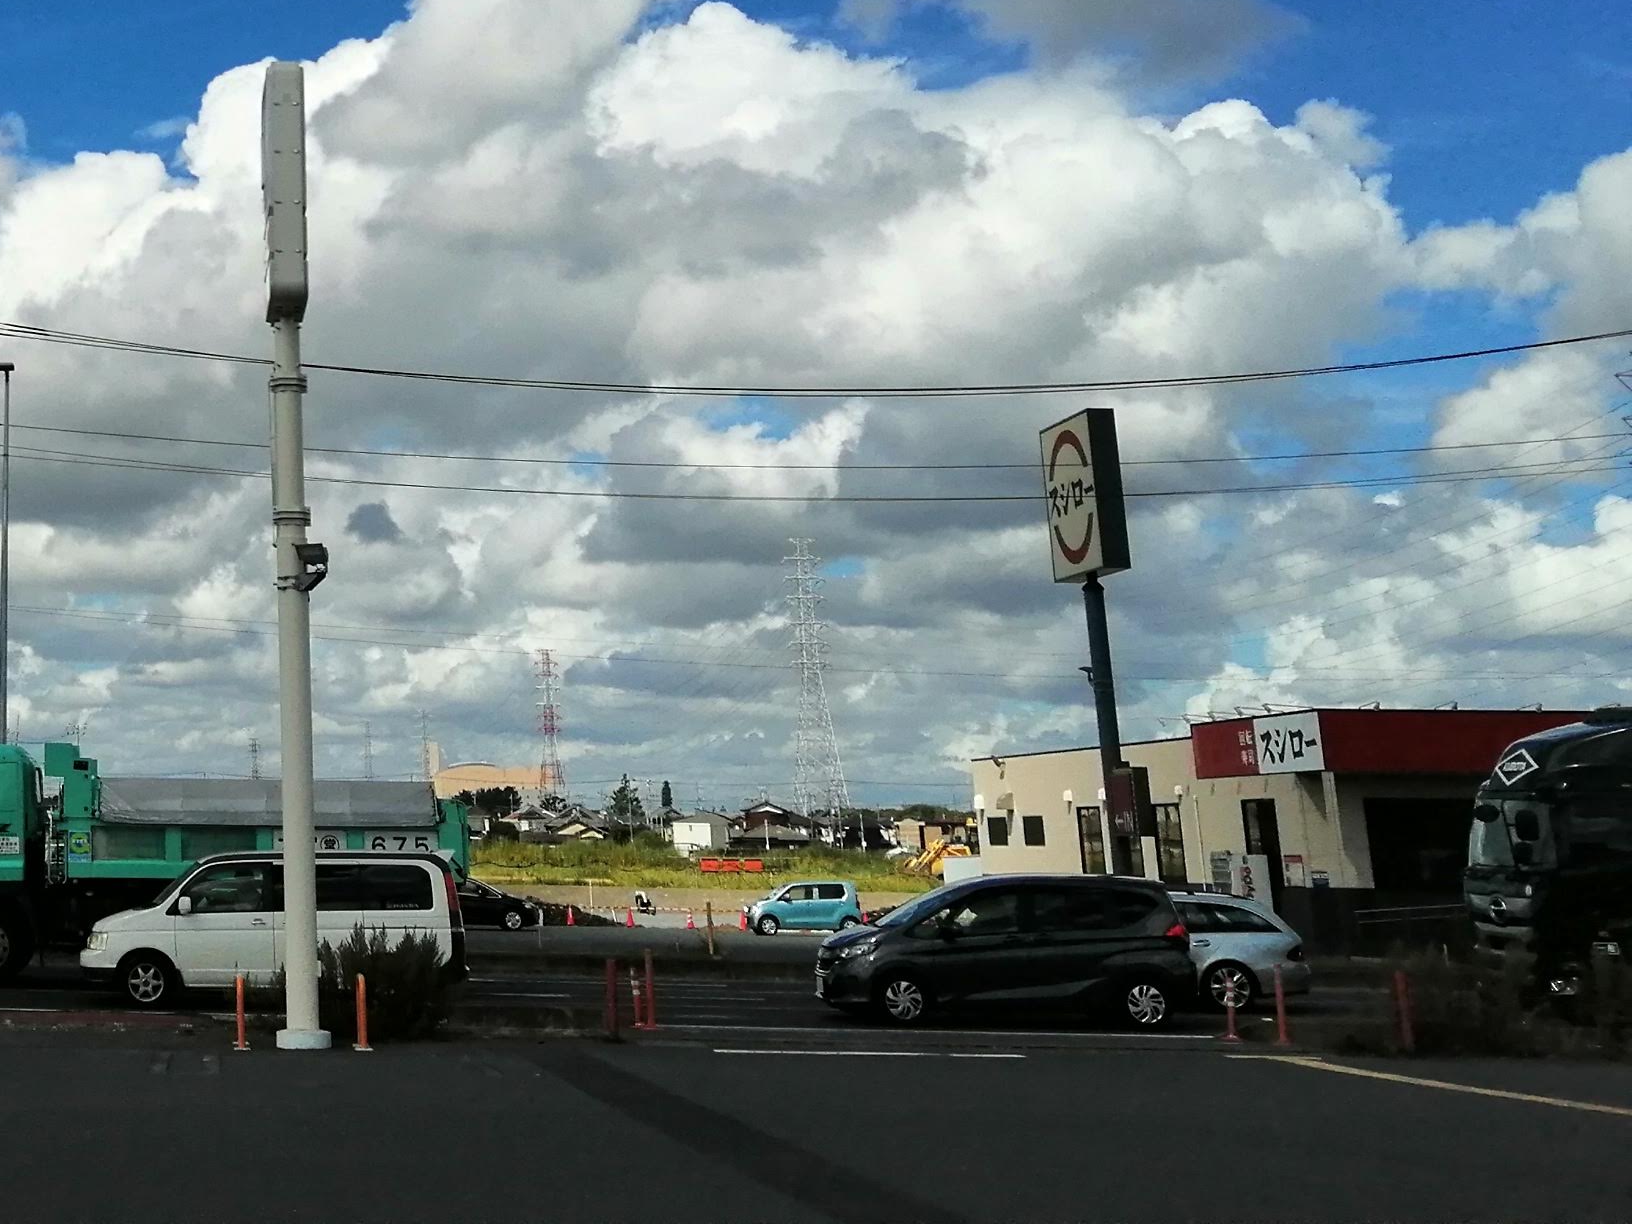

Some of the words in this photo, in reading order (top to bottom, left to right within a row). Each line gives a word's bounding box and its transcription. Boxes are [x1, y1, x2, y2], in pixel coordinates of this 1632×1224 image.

[1049, 479, 1094, 519] スシロー
[1260, 727, 1317, 765] スシロー
